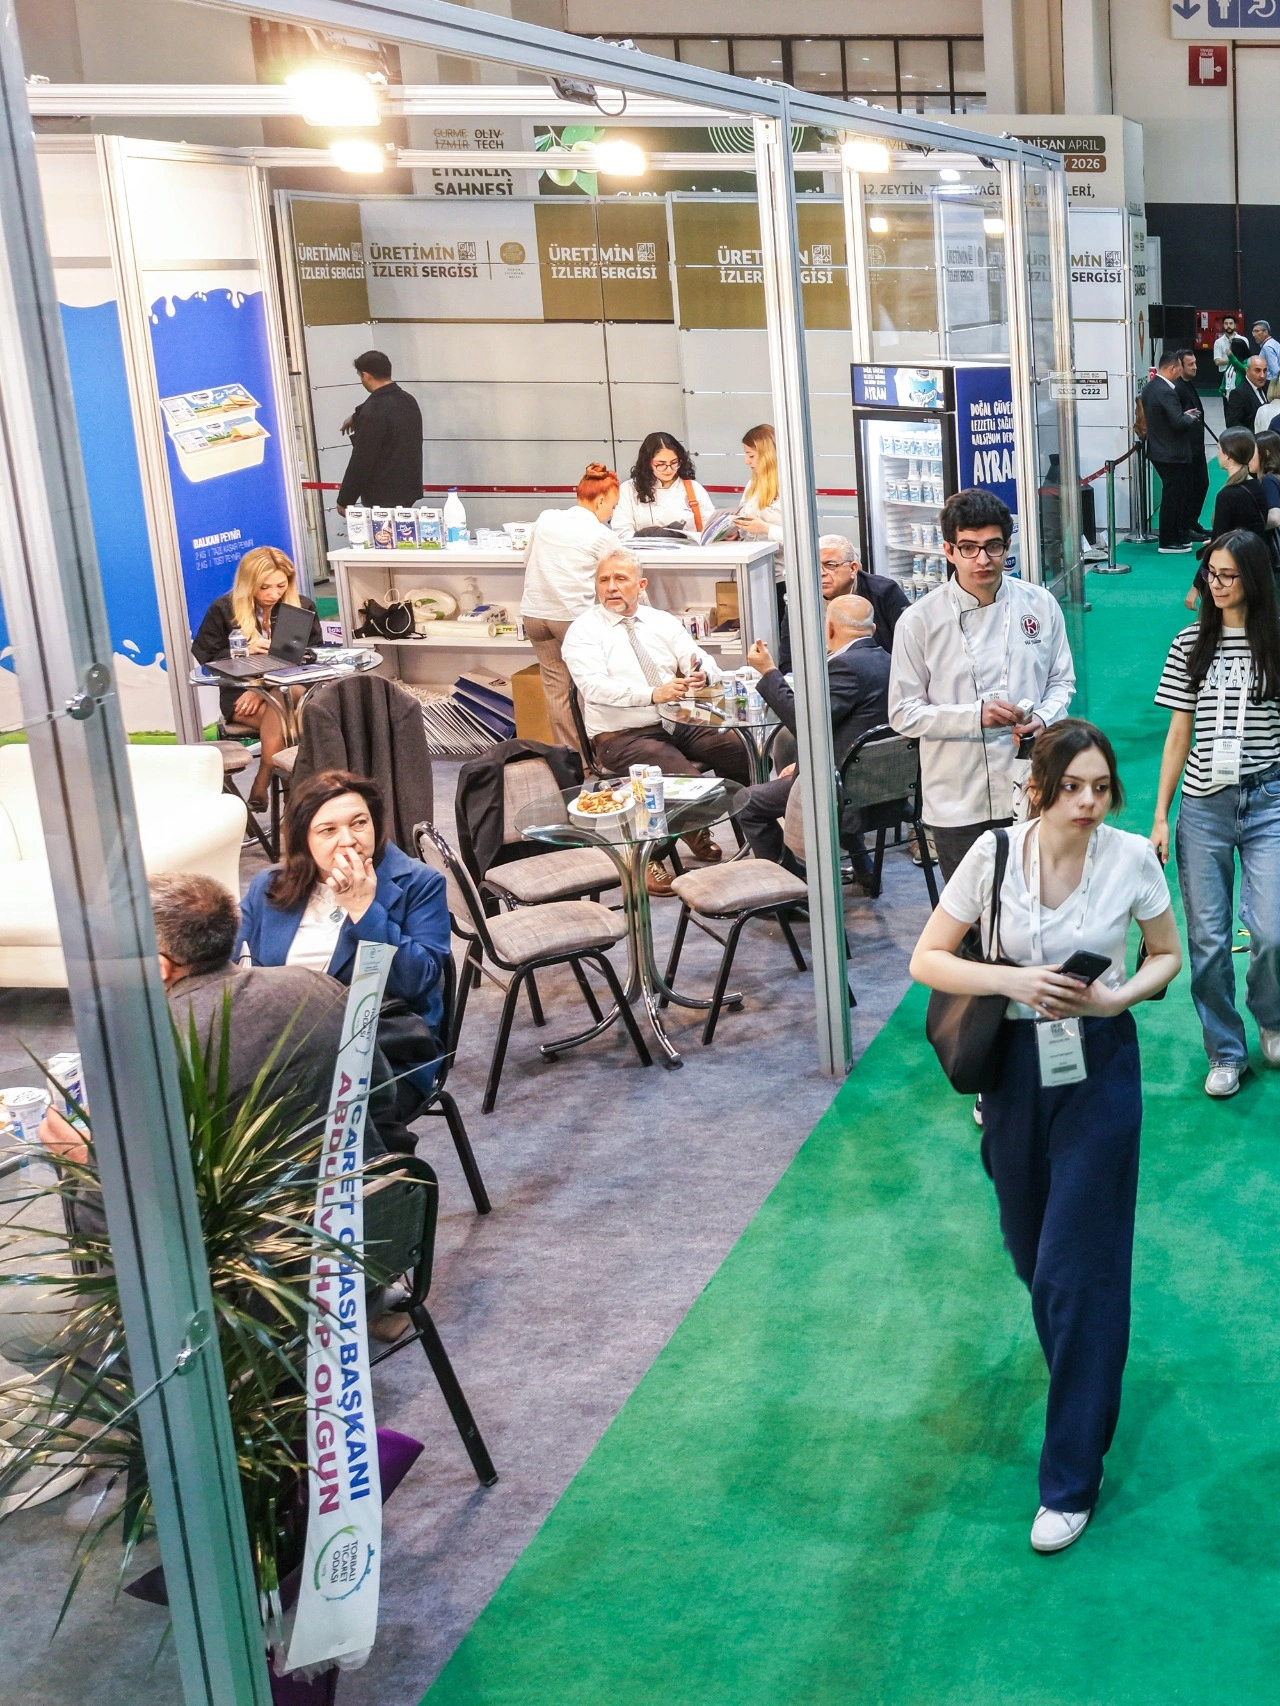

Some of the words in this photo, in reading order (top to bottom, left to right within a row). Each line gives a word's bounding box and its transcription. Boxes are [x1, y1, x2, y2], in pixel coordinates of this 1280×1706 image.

[477, 139, 504, 149] TECH
[1068, 139, 1100, 151] APRIL
[1071, 158, 1100, 169] 2026
[435, 178, 514, 195] SAHNESİ
[298, 242, 350, 262] ÜRETİMİN
[371, 243, 455, 261] ÜRETİMİN
[549, 244, 634, 262] ÜRETİMİN
[301, 262, 330, 280] İZLERİ
[331, 263, 365, 280] SERGİSİ
[373, 263, 419, 278] İZLERİ
[422, 263, 478, 278] SERGİSİ
[551, 264, 598, 279] İZLERİ
[601, 266, 657, 279] SERGİSİ
[720, 268, 764, 284] İZLER
[1071, 269, 1122, 283] SERGİSİ
[864, 386, 886, 400] AYRAN
[970, 400, 992, 417] DOĞAL
[971, 432, 1001, 445] KALSİYUM
[193, 534, 219, 549] BALKAN
[219, 528, 241, 543] PEYNİR
[339, 1071, 370, 1215] TCARET
[337, 1342, 370, 1501] BAŞKANI
[314, 1364, 341, 1516] OLGUN
[331, 1551, 340, 1584] ODASI
[349, 1540, 358, 1582] TORBALI
